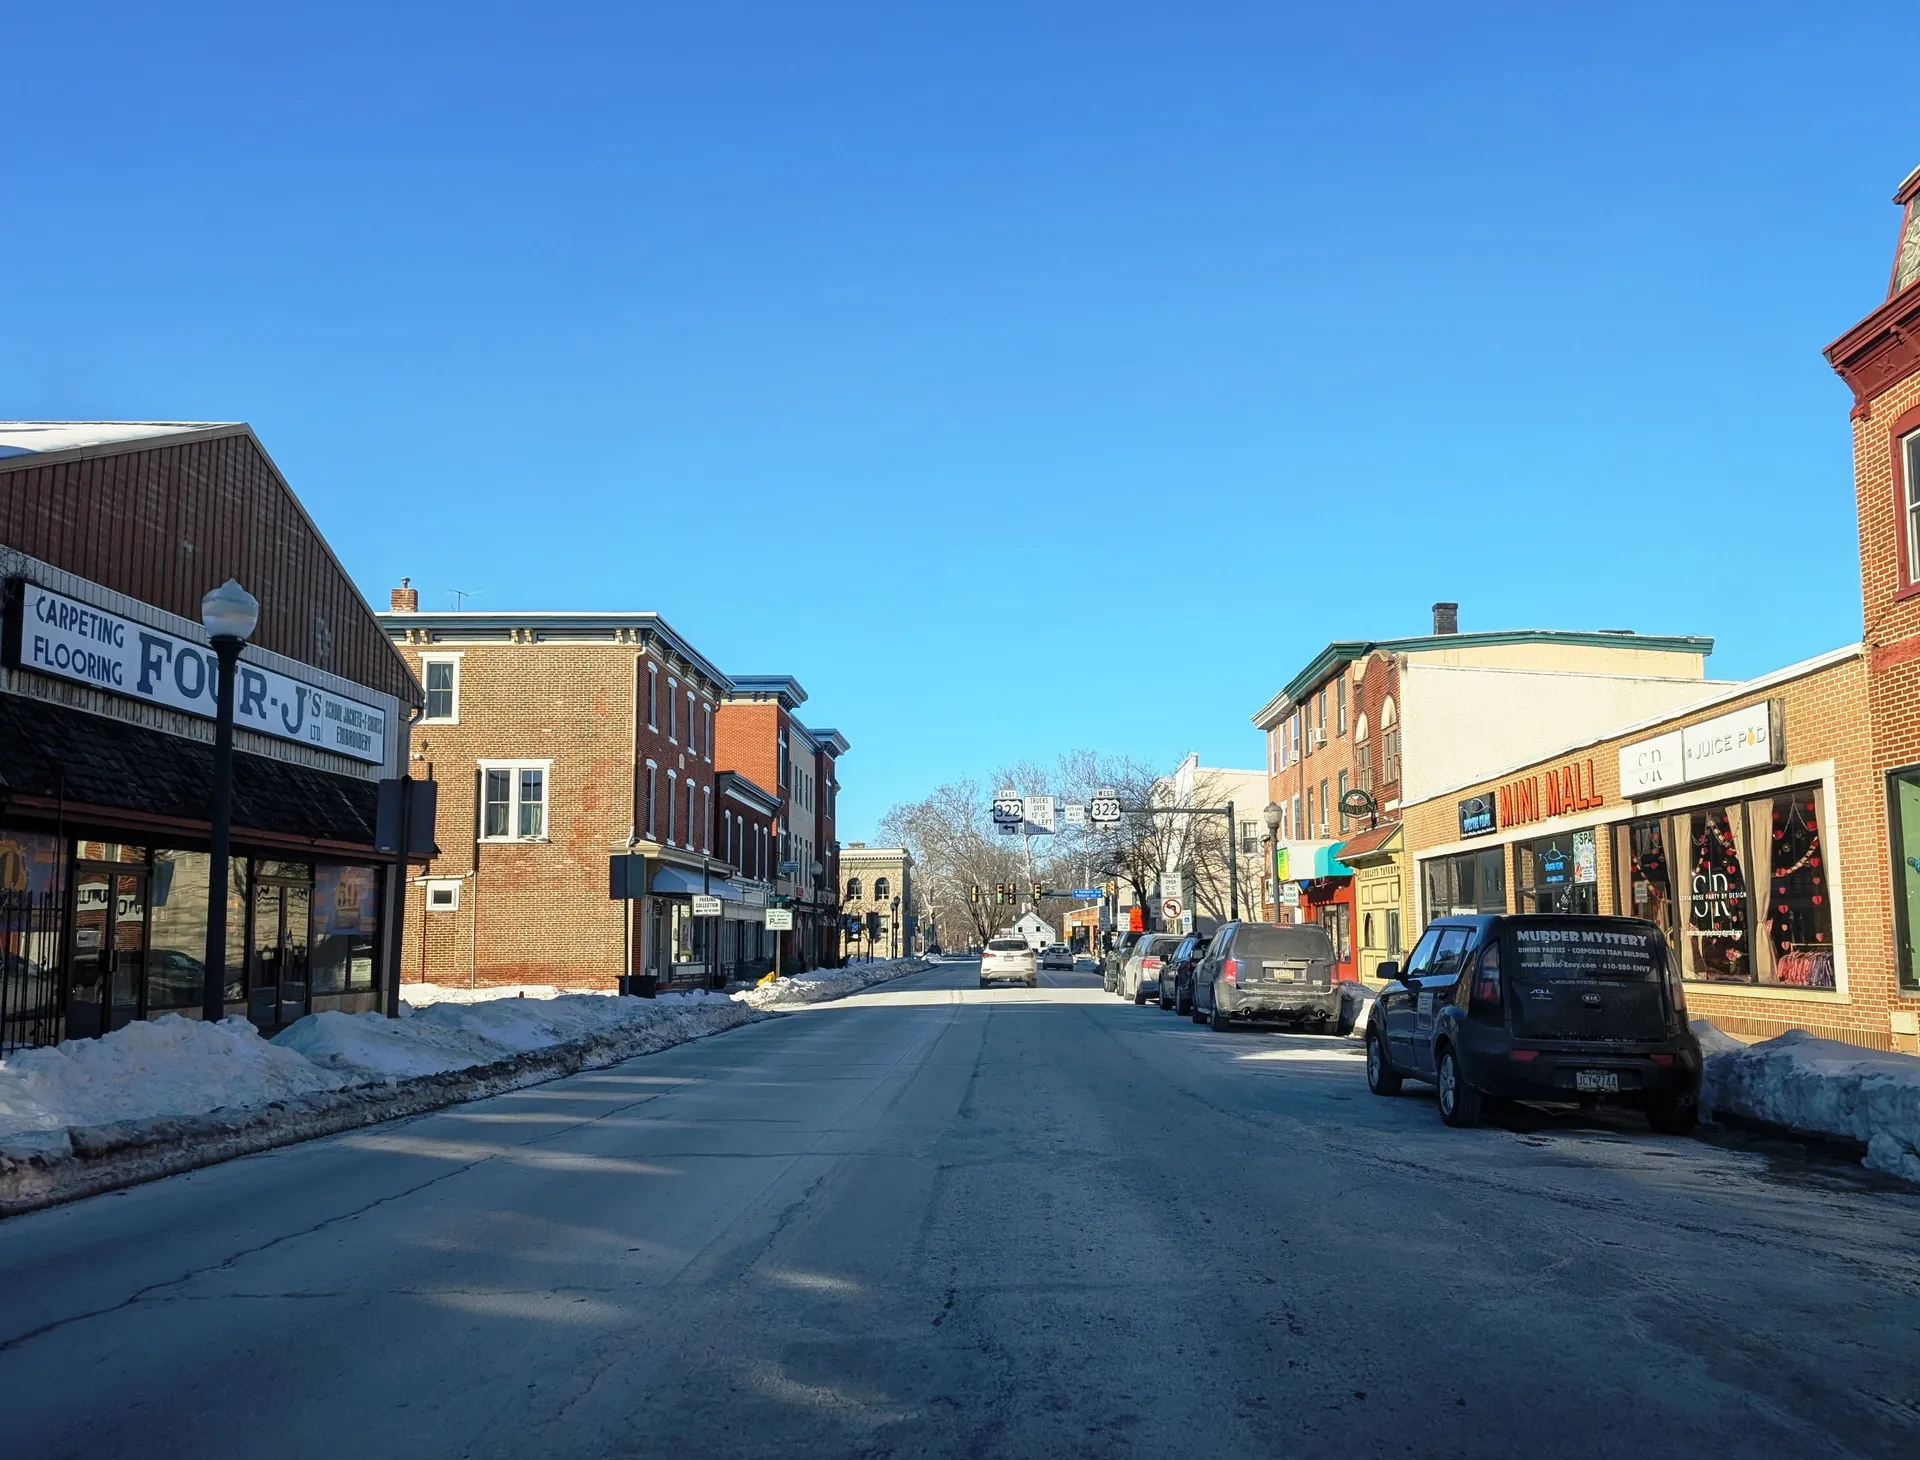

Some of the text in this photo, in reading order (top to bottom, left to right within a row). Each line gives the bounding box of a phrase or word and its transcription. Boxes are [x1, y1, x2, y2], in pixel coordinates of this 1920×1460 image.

[36, 596, 125, 649] CARPETING
[33, 635, 123, 686] FLOORING
[1695, 735, 1732, 760] JUICE
[1500, 758, 1603, 828] MINI MALL
[996, 804, 1020, 817] 322
[1094, 803, 1118, 816] 322
[1341, 803, 1374, 814] TAVERN
[1579, 832, 1592, 845] SPA
[338, 881, 358, 907] 50
[1516, 930, 1647, 946] MURDER MYSTERY
[1572, 948, 1606, 956] CORPORATE
[1623, 951, 1650, 959] BUILDING
[1520, 961, 1650, 972] www.Music-Envy.com 610-280-ENVY
